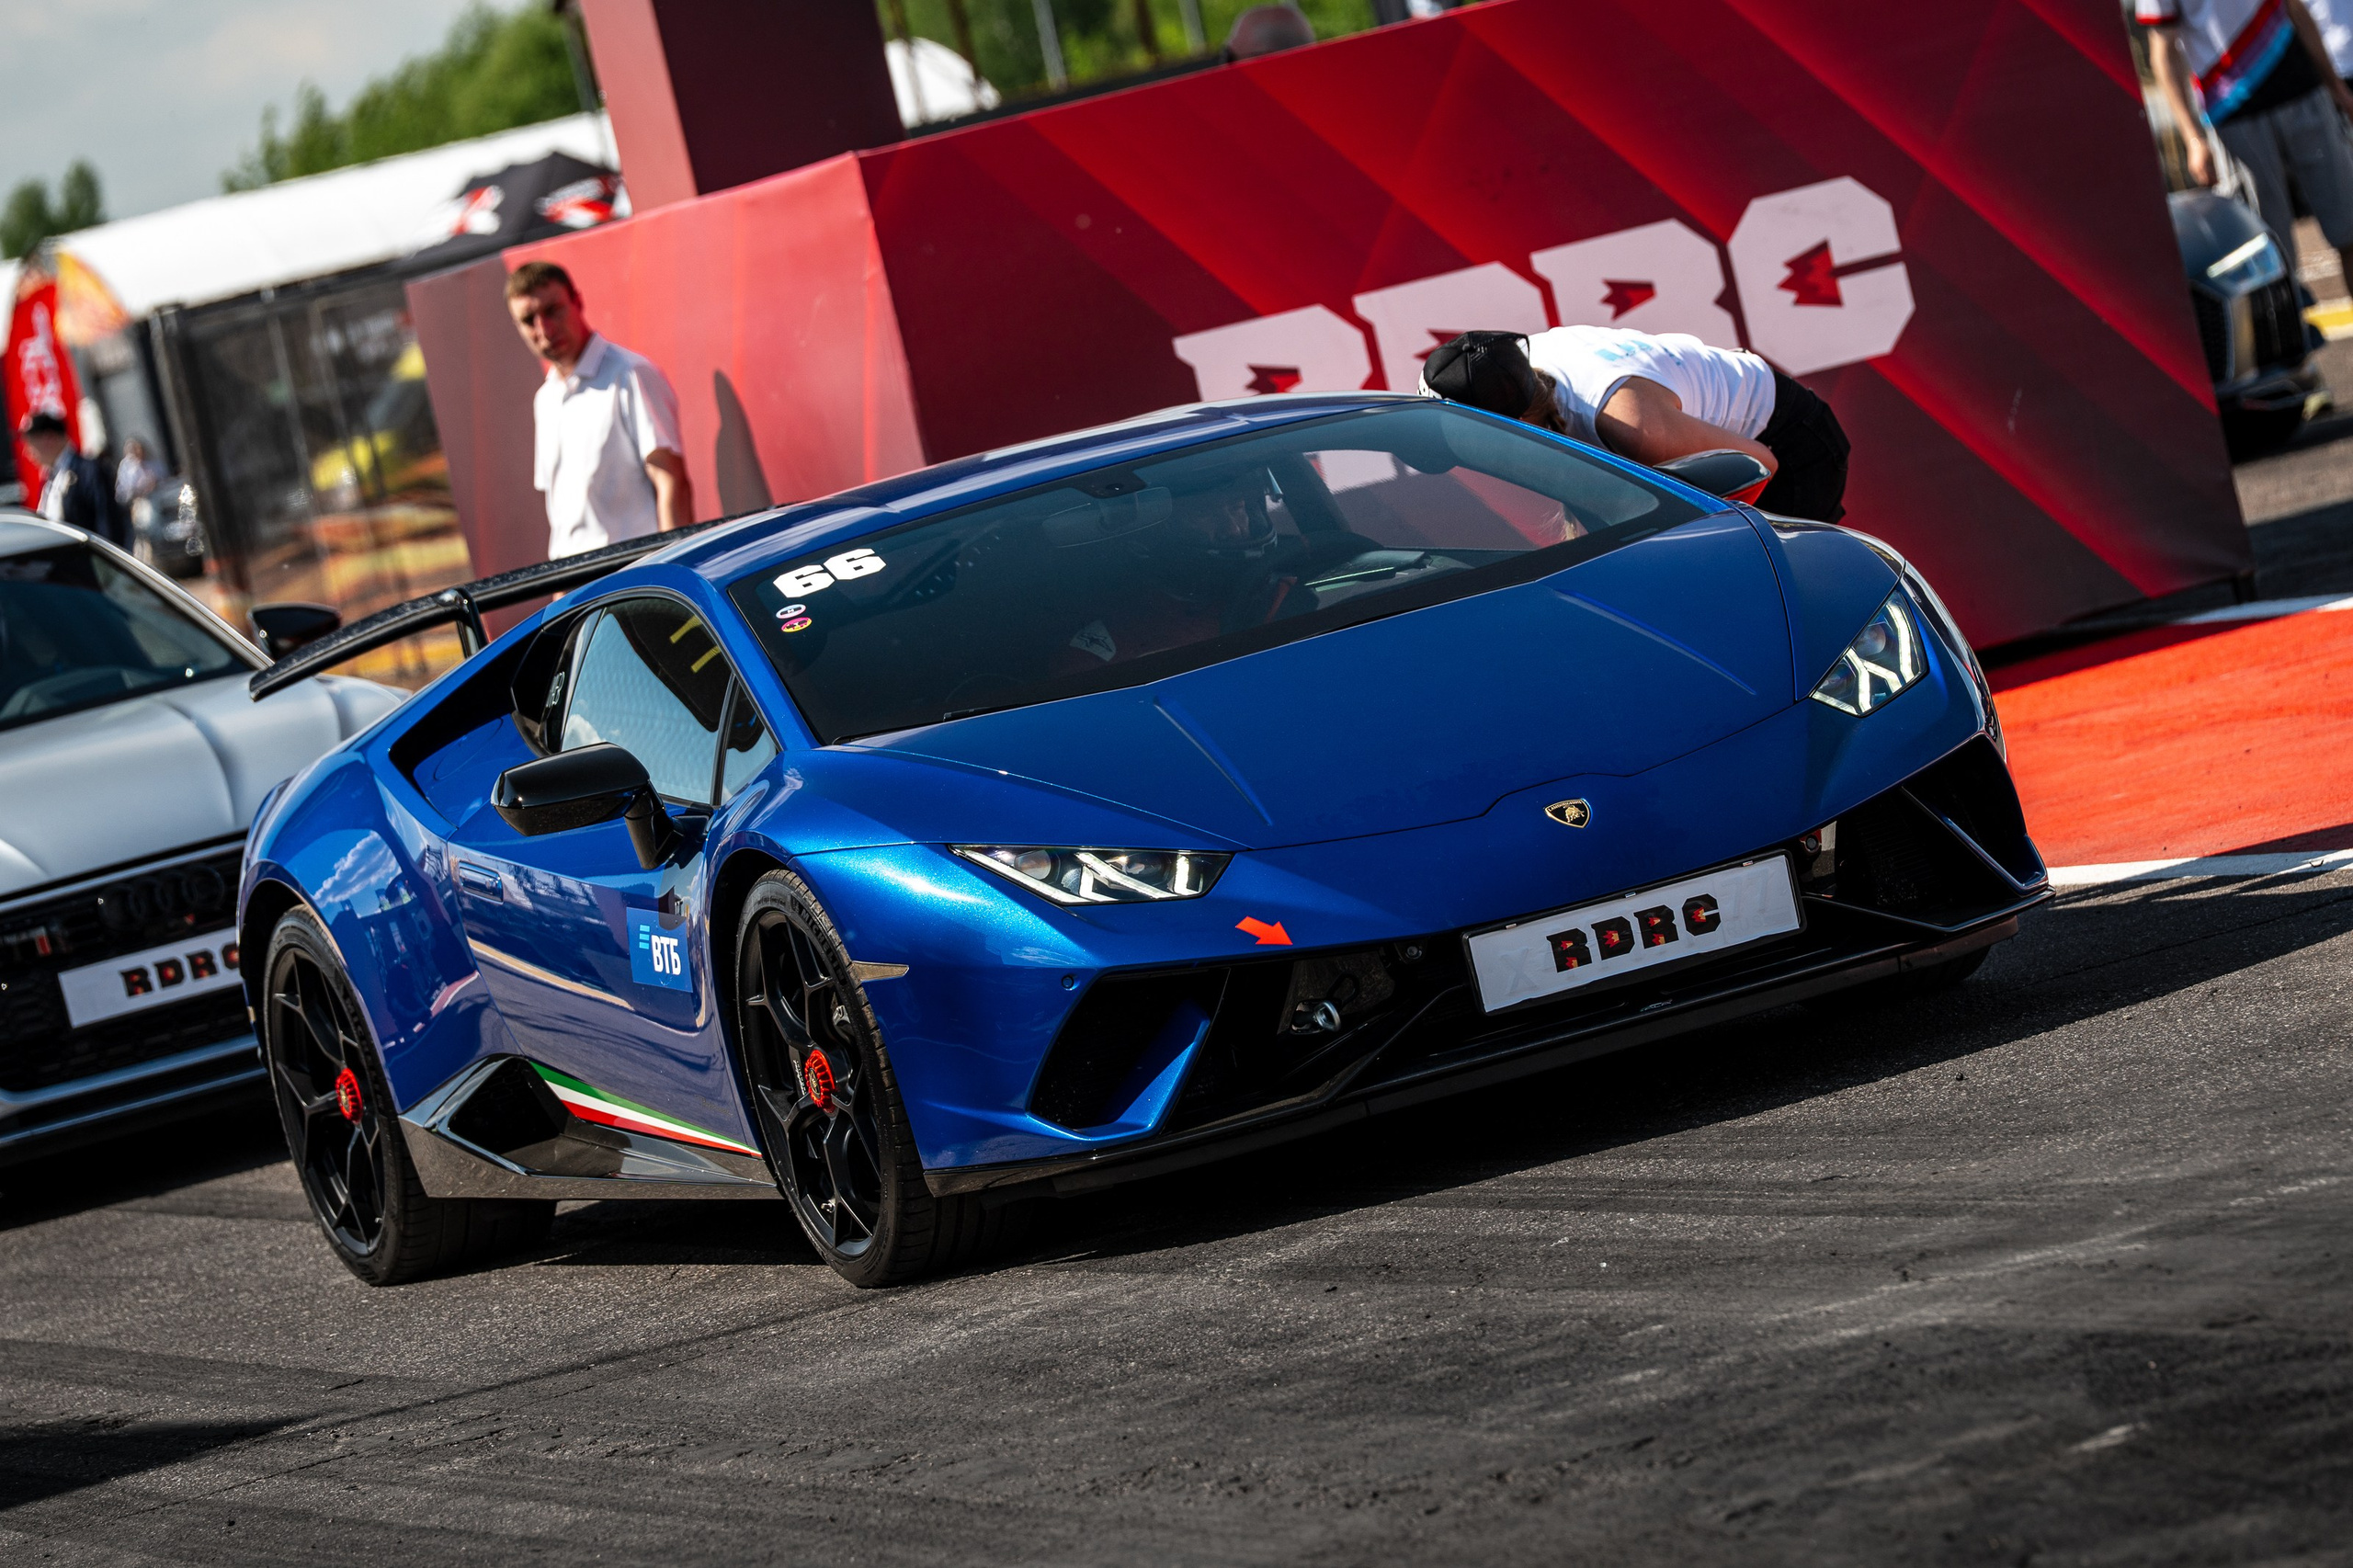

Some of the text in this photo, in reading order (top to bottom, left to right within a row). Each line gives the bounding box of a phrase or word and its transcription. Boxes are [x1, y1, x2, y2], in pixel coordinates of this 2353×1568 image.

[773, 549, 886, 598] 66
[651, 935, 681, 975] ВТБ
[1546, 893, 1722, 973] RDRC
